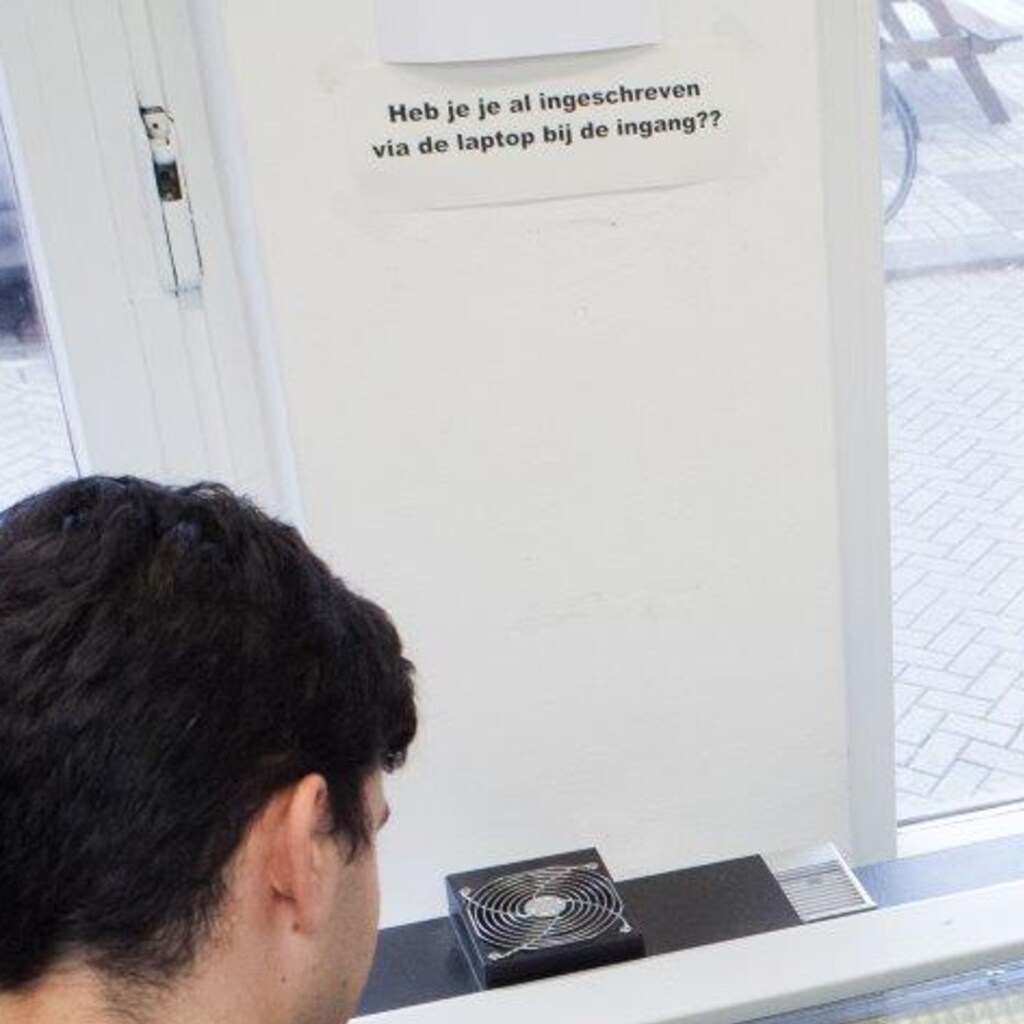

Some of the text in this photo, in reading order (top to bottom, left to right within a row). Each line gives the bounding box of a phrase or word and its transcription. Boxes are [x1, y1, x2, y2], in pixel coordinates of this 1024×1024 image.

[388, 83, 701, 124] Heb je je al ingeschreven
[372, 110, 722, 158] via de laptop bij de ingang??
